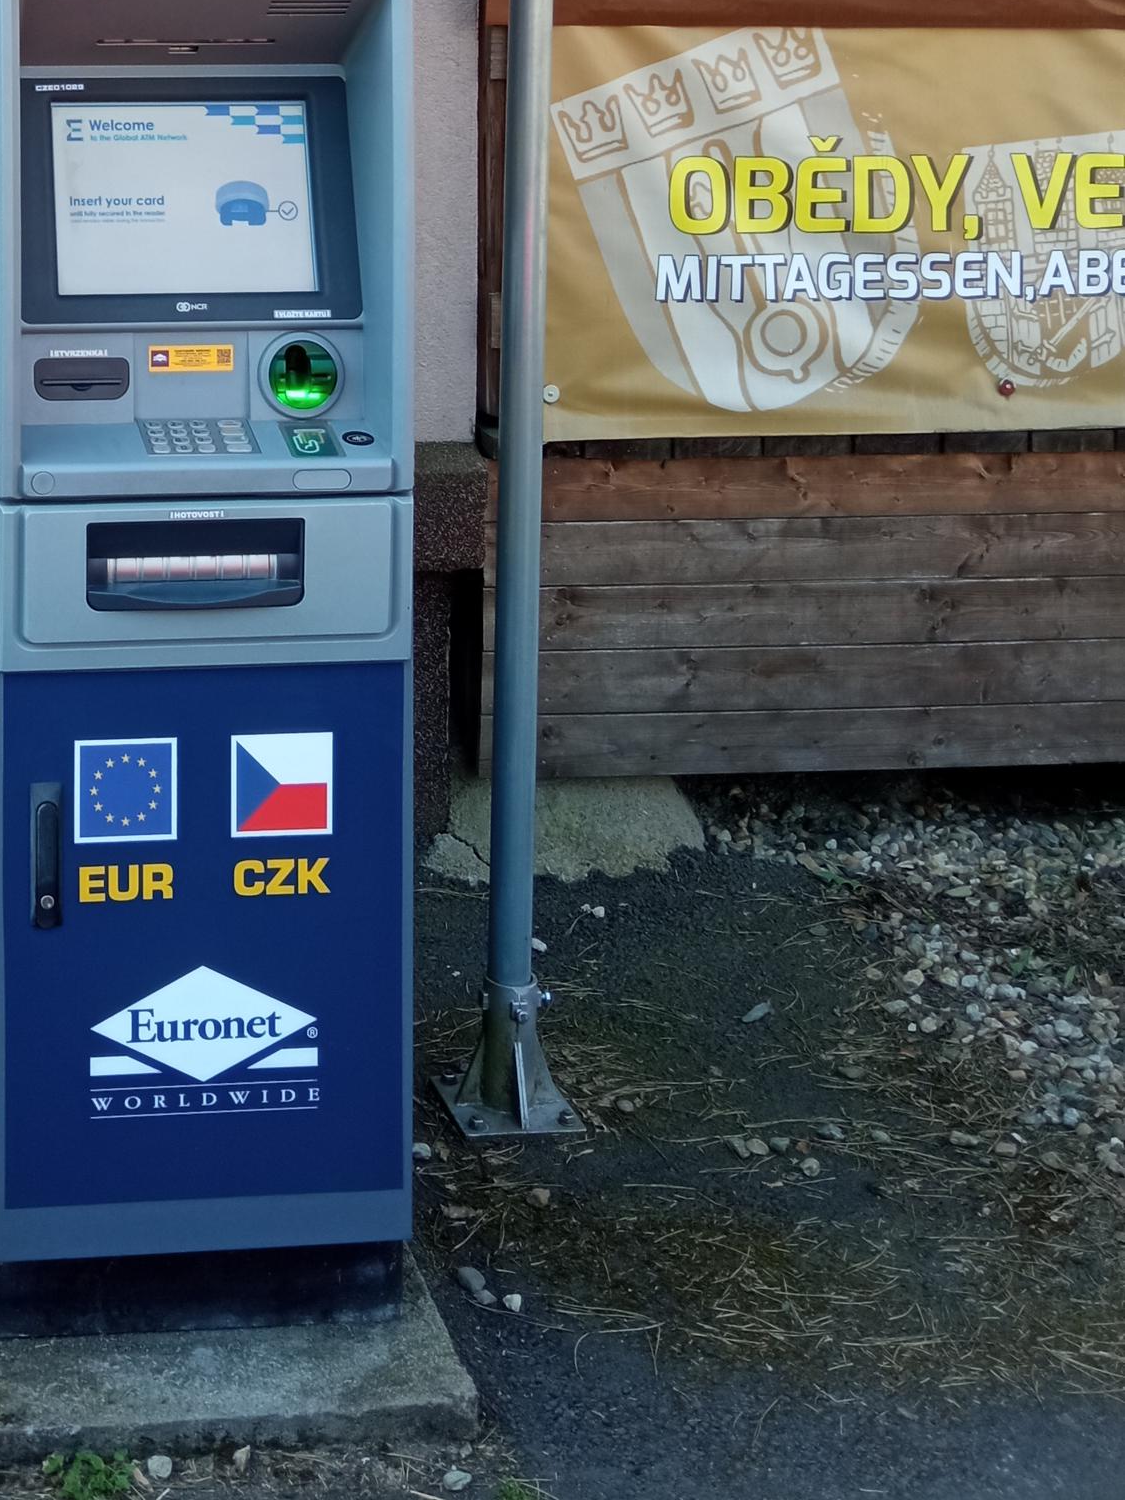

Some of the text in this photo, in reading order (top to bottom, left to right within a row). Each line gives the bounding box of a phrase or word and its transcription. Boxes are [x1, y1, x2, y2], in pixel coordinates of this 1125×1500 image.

[89, 119, 154, 131] Welcome
[69, 195, 165, 208] Insert your card
[668, 136, 982, 240] OBĚDY,
[79, 863, 174, 903] EUR
[233, 857, 331, 896] CZK
[126, 1008, 281, 1044] Euronet
[91, 1087, 321, 1112] WORLDWIDE
